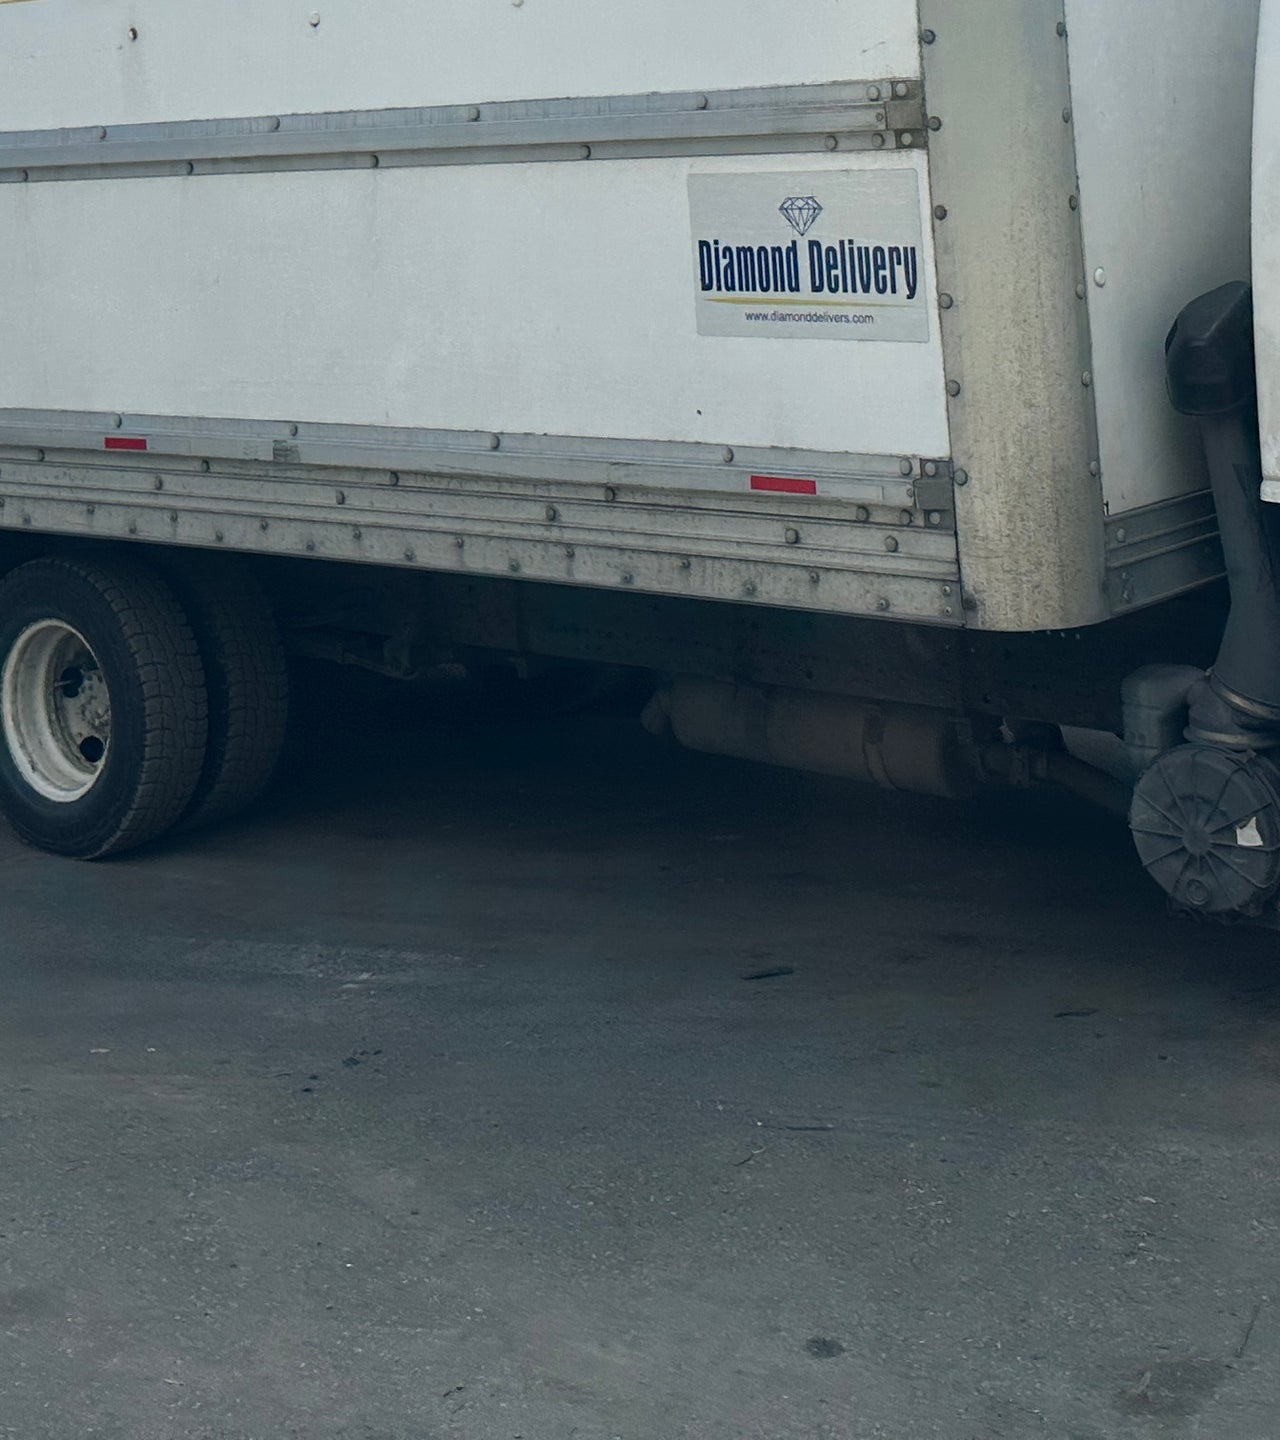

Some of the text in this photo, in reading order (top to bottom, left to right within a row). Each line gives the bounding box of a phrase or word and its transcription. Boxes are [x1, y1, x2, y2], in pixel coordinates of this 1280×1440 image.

[697, 239, 918, 300] Diamond Delivery
[744, 311, 874, 325] www.diamonddelivers.com
